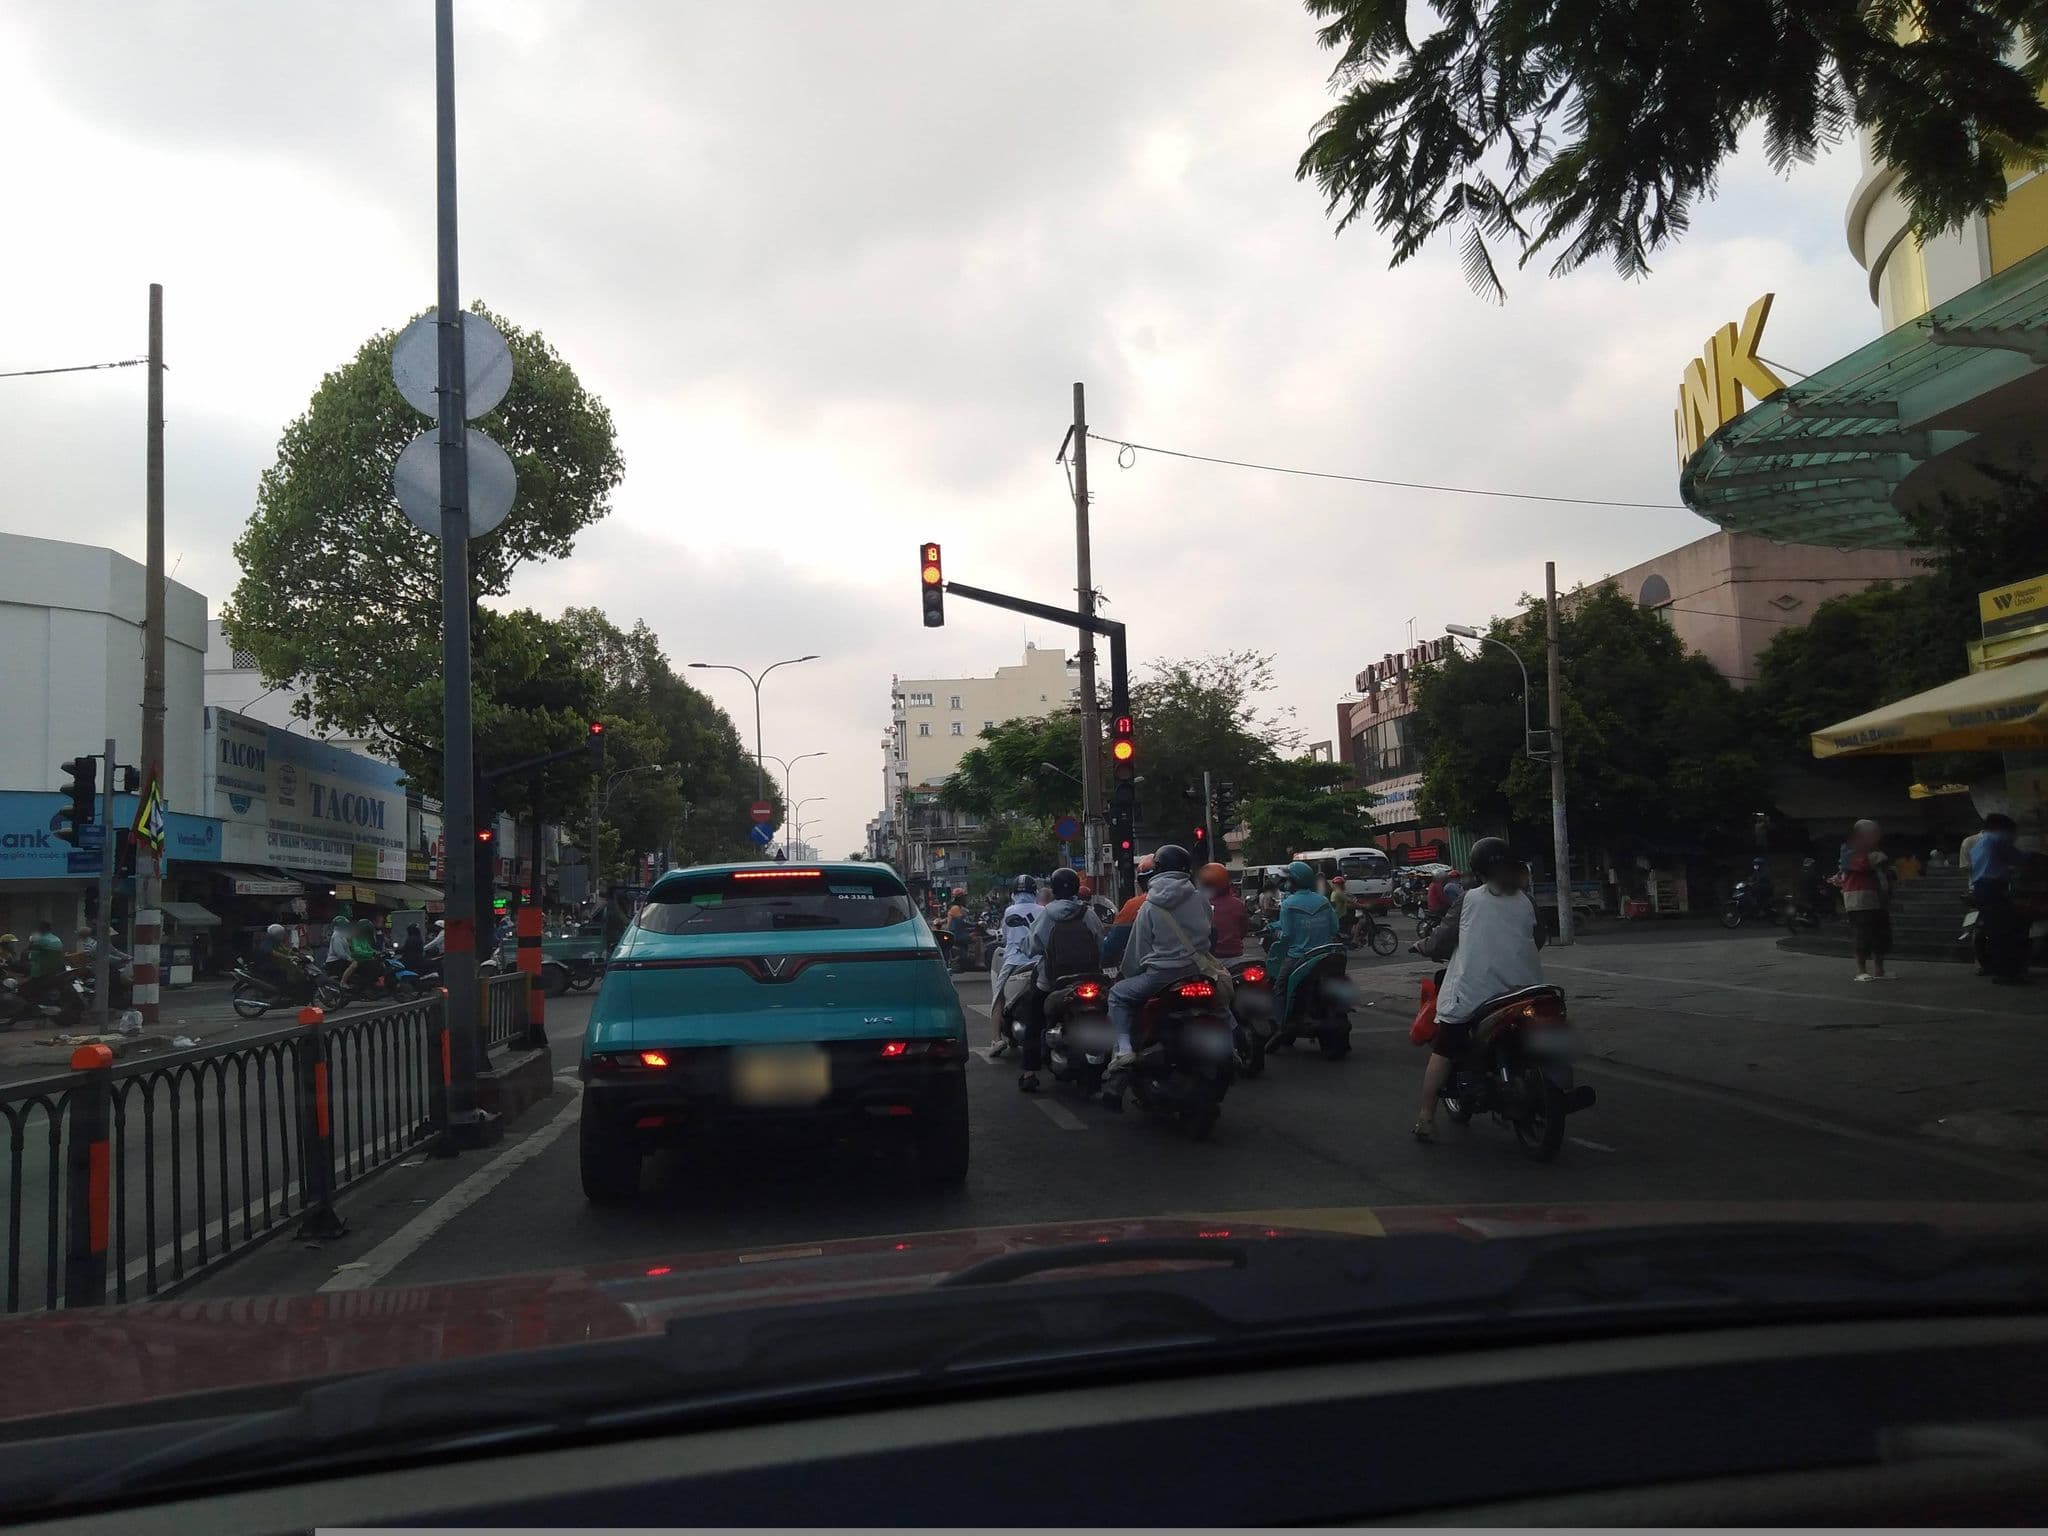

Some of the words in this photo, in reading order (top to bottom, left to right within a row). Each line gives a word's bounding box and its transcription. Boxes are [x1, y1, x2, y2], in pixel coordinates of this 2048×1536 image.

[1675, 293, 1787, 478] ANK
[220, 738, 265, 773] TACOM
[310, 782, 385, 830] TACOM
[0, 828, 50, 849] ank
